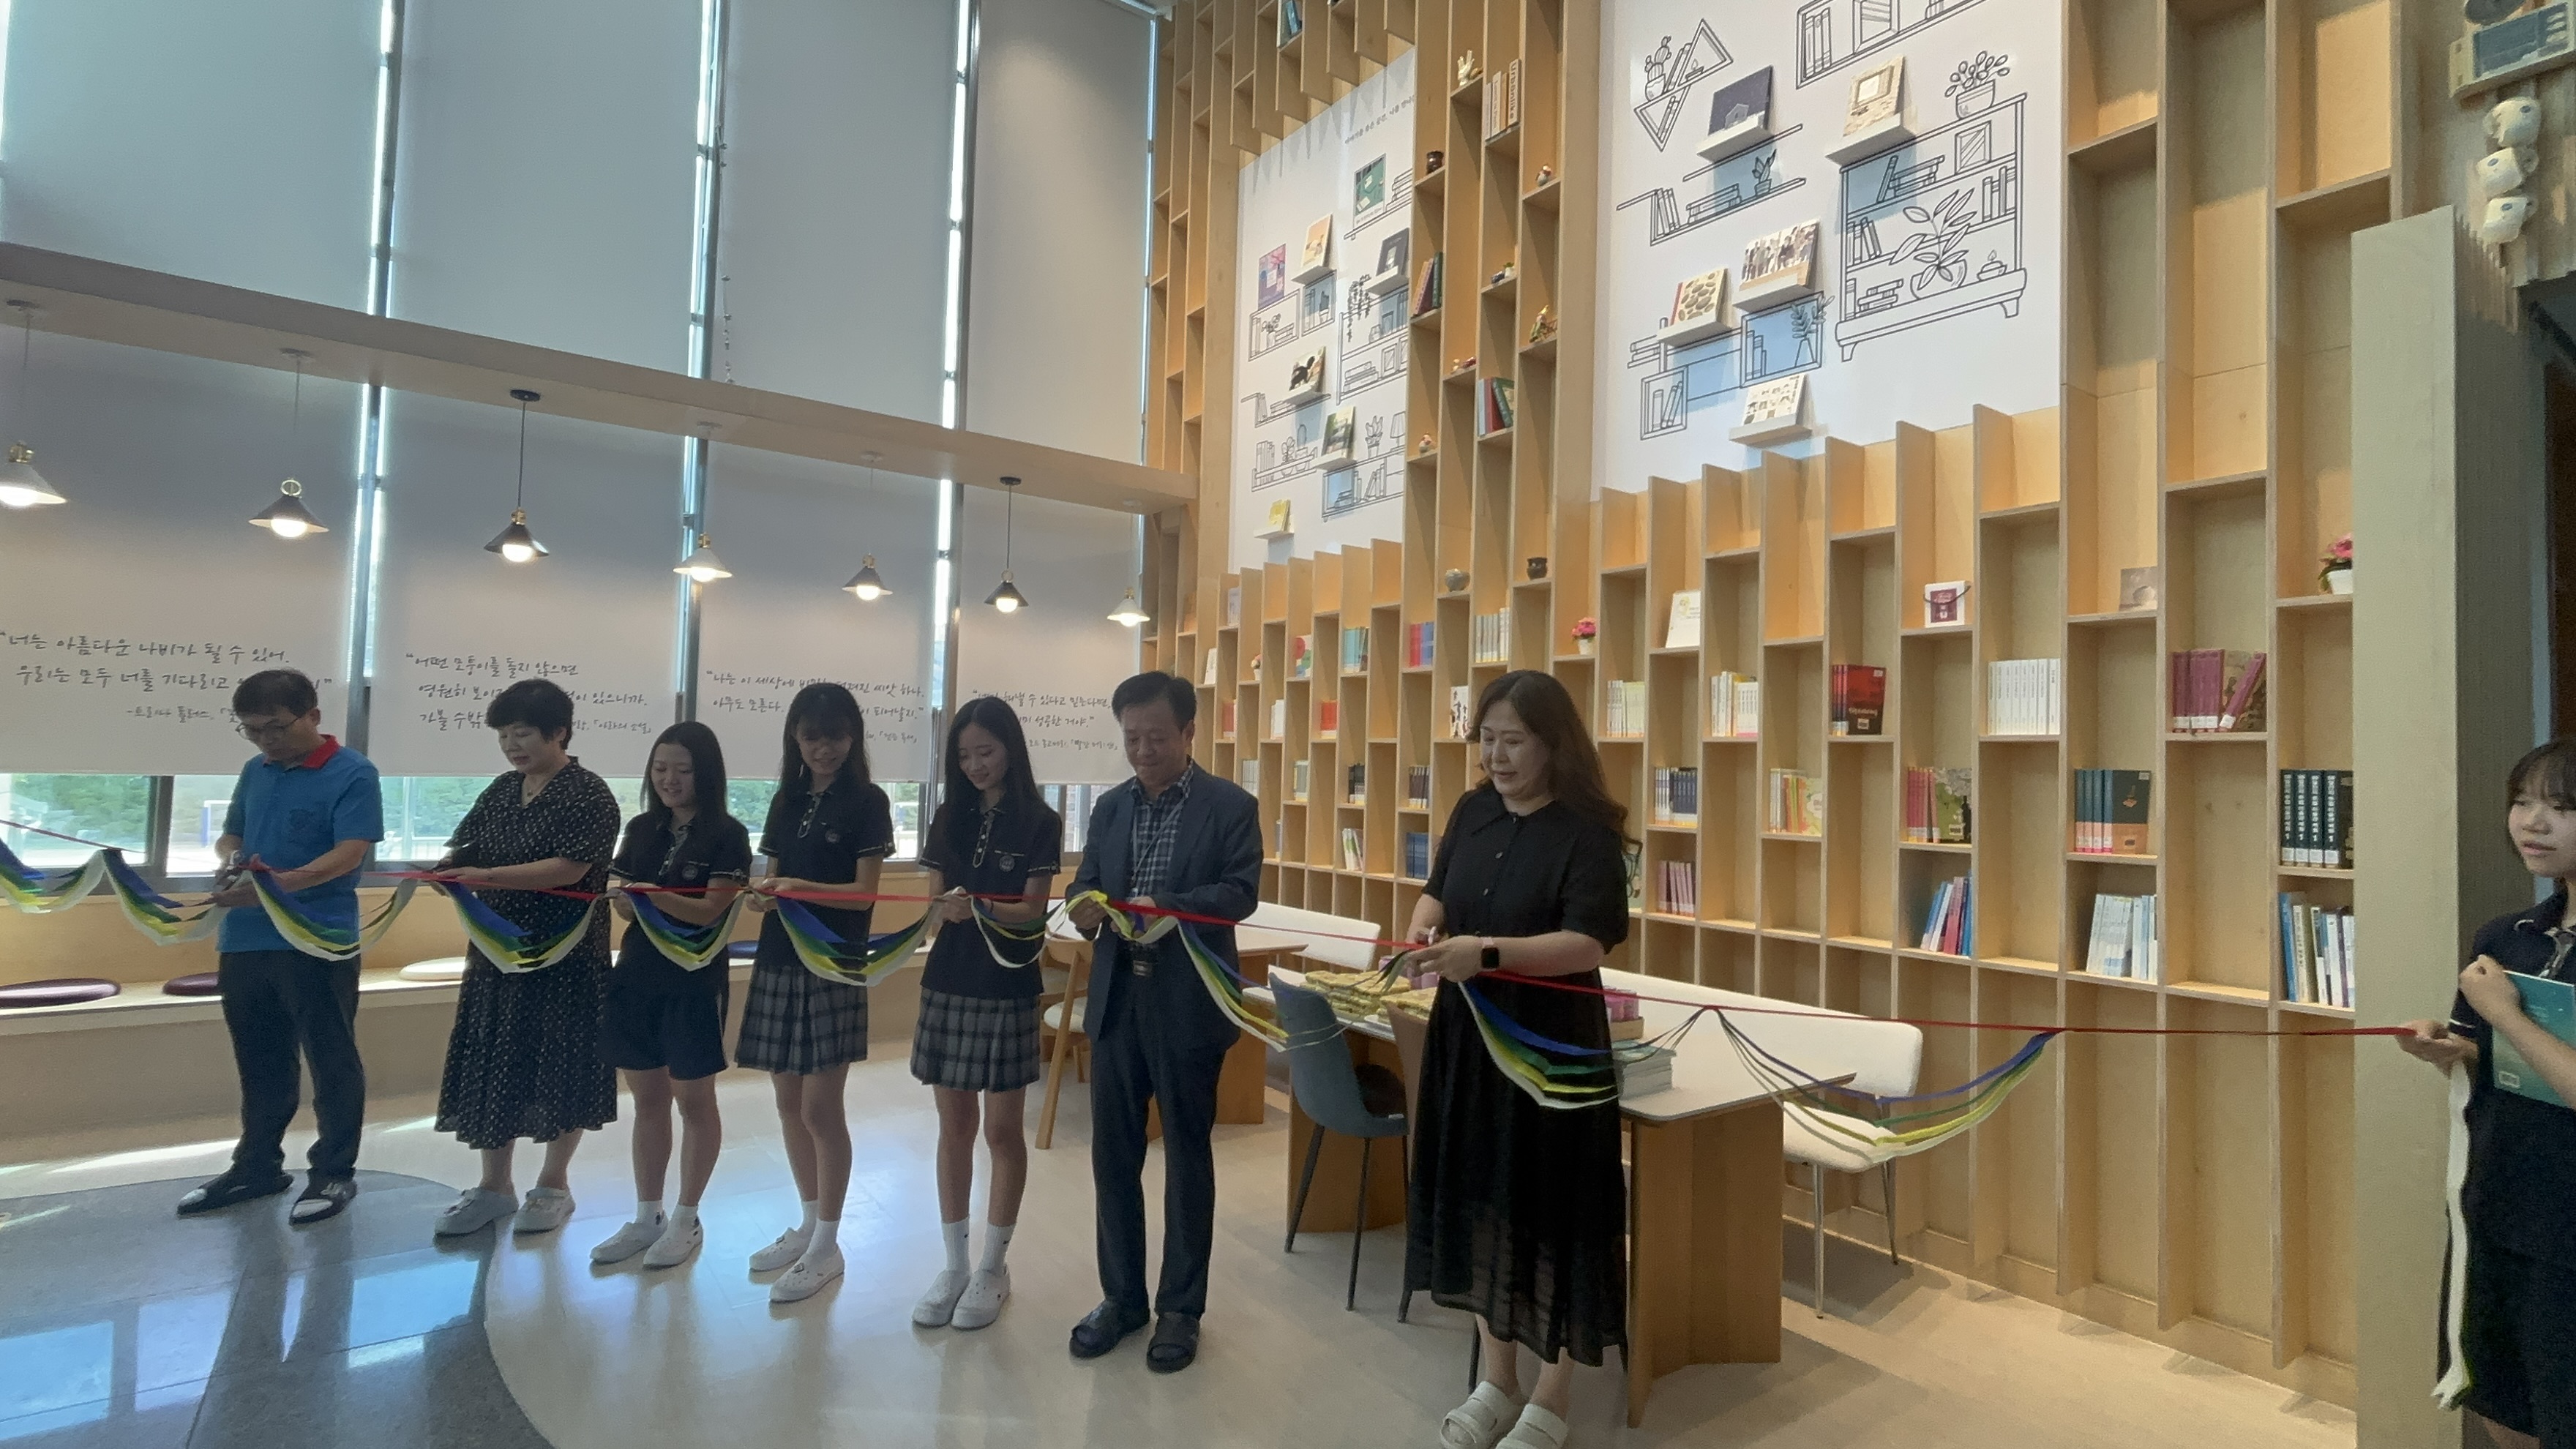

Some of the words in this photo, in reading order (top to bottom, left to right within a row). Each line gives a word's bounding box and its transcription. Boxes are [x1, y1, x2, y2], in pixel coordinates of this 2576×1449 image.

[56, 635, 131, 656] 아름다운
[139, 642, 197, 656] 나비가
[205, 643, 222, 664] 될
[229, 645, 246, 665] 수
[252, 647, 290, 663] 있어.
[454, 655, 500, 678] 모퉁이를
[506, 657, 530, 679] 돌지
[535, 661, 578, 677] 않으면
[16, 665, 71, 686] 우리는
[79, 667, 112, 689] 모두
[121, 668, 154, 692] 너를
[162, 673, 230, 690] 기다리고
[741, 676, 752, 684] 이
[755, 676, 795, 689] 세상에
[419, 683, 466, 699] 영원히
[592, 691, 648, 705] 있으니까.
[873, 683, 896, 698] 씨앗
[899, 683, 924, 697] 하나.
[713, 696, 744, 713] 아무도
[749, 697, 785, 714] 모른다.
[1028, 693, 1037, 708] 수
[1040, 694, 1066, 705] 있다고
[419, 708, 448, 731] 가볼
[454, 711, 484, 730] 수밖
[1035, 714, 1062, 727] 성공한
